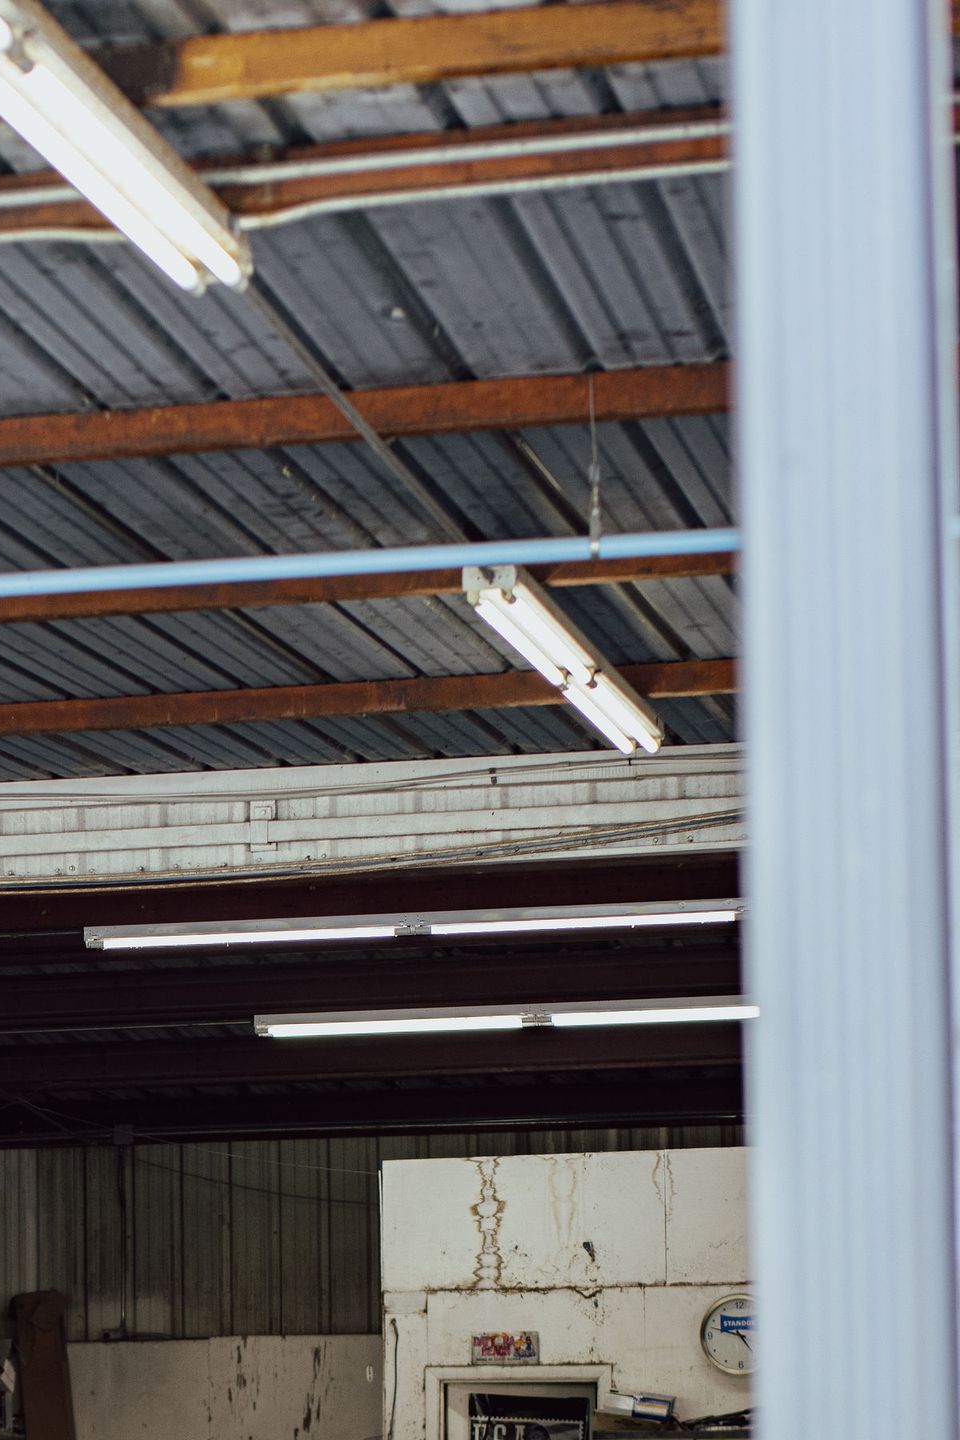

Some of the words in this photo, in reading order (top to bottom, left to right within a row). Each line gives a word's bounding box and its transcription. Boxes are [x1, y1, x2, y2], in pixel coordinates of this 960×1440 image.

[735, 1301, 744, 1309] 12
[707, 1331, 713, 1340] 9
[738, 1361, 744, 1369] 6
